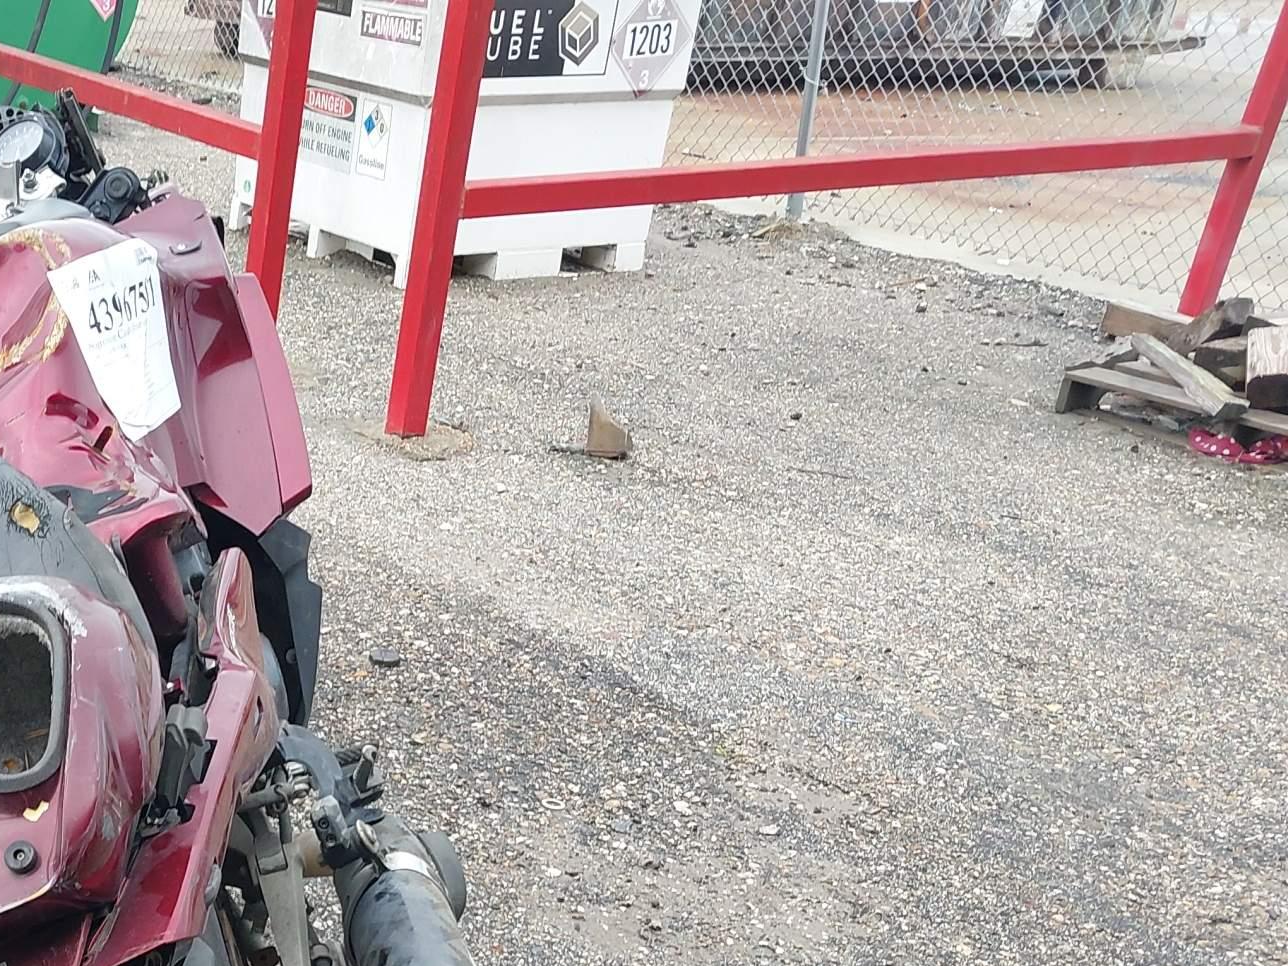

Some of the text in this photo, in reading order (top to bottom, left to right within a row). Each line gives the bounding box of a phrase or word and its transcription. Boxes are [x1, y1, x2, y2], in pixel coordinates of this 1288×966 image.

[363, 12, 422, 42] FLAMMABLE
[490, 9, 544, 35] UEL
[487, 36, 544, 61] UBE
[628, 22, 672, 57] 1203
[638, 70, 649, 87] 3
[307, 89, 346, 117] DANGER
[302, 118, 352, 143] URN OFF ENGINE
[315, 141, 350, 162] REFUELING
